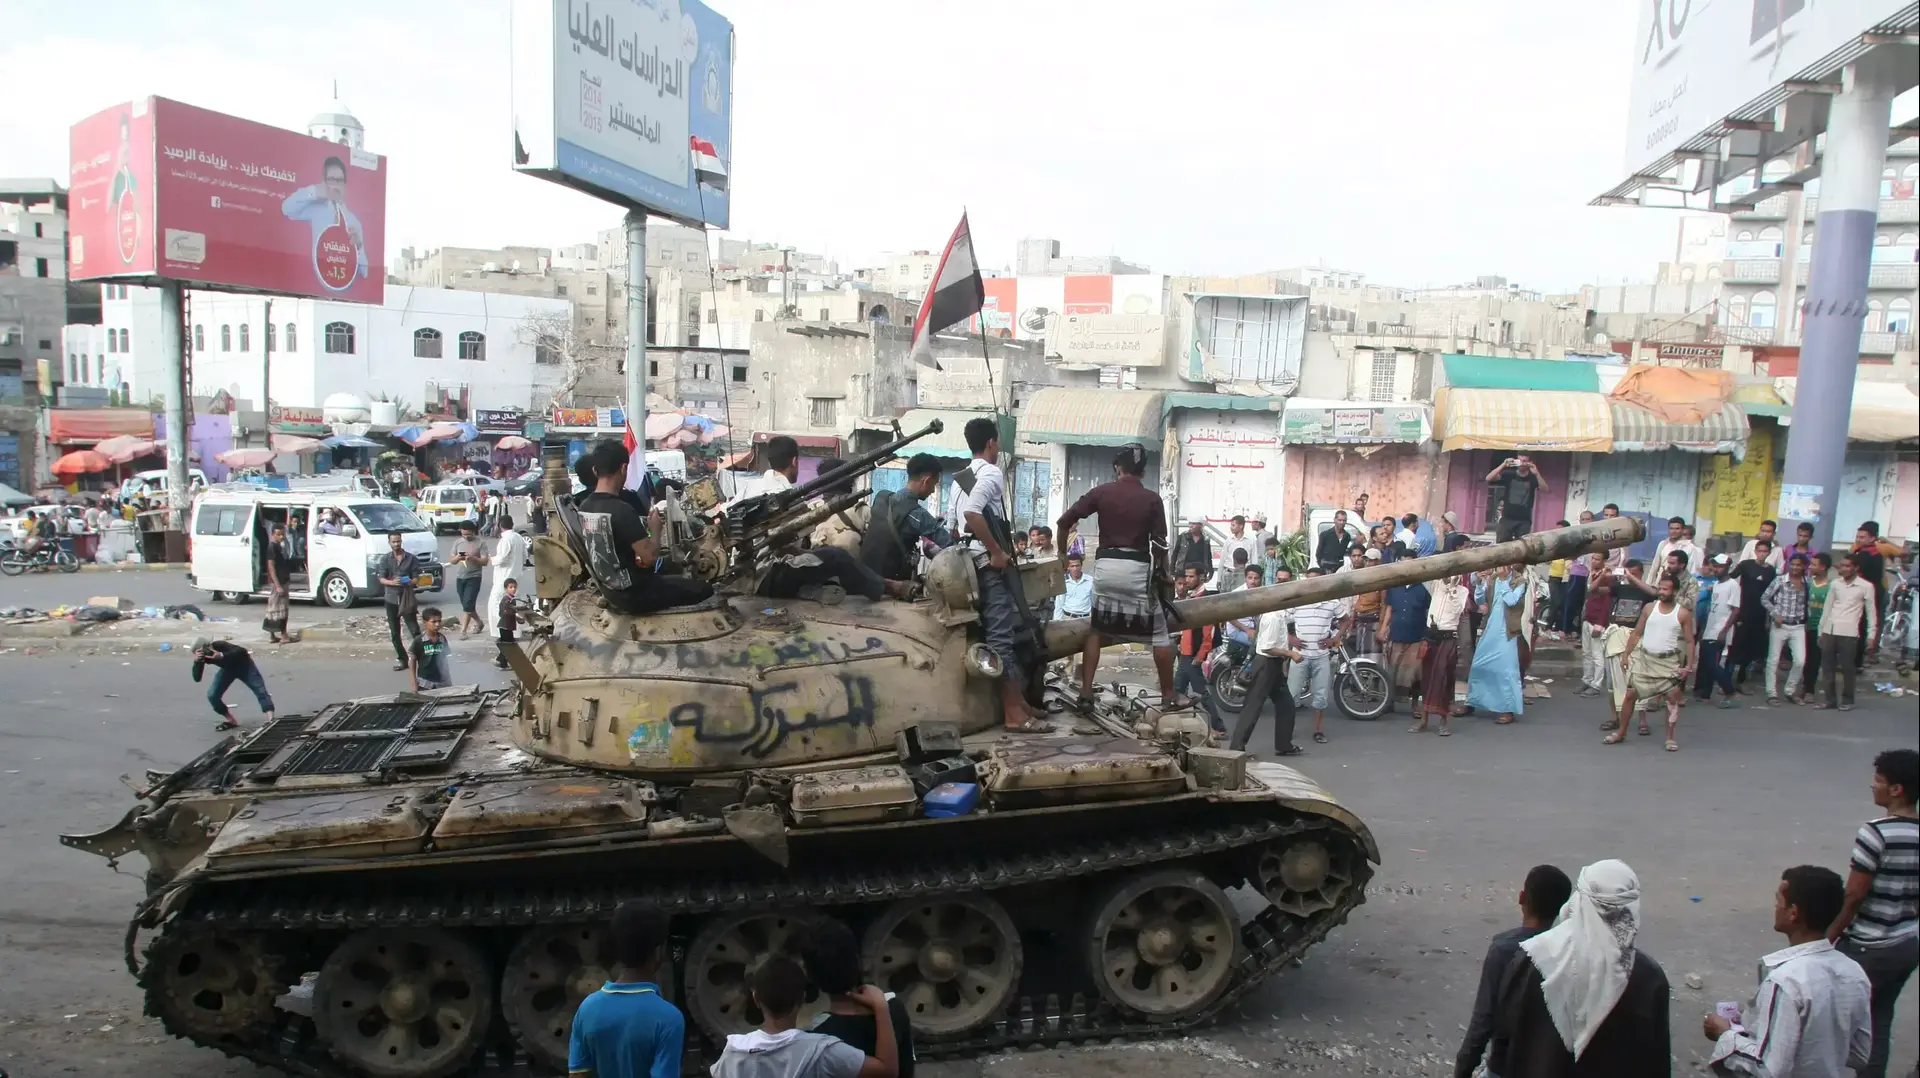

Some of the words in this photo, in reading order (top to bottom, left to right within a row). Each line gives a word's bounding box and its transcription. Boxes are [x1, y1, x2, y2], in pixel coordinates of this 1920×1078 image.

[568, 0, 614, 62] العليا
[618, 31, 682, 99] الدراسات
[583, 83, 602, 105] 2014
[583, 110, 602, 134] 2015
[608, 101, 661, 144] الماجستير
[163, 145, 196, 163] الرصيد
[198, 151, 228, 171] بزيادة
[240, 162, 259, 178] يزيد
[260, 165, 297, 183] تخفيضك
[323, 241, 350, 254] دقيقتي
[283, 407, 324, 426] صيدلية
[1221, 429, 1278, 447] صيدلية
[1186, 452, 1265, 474] صيدلية
